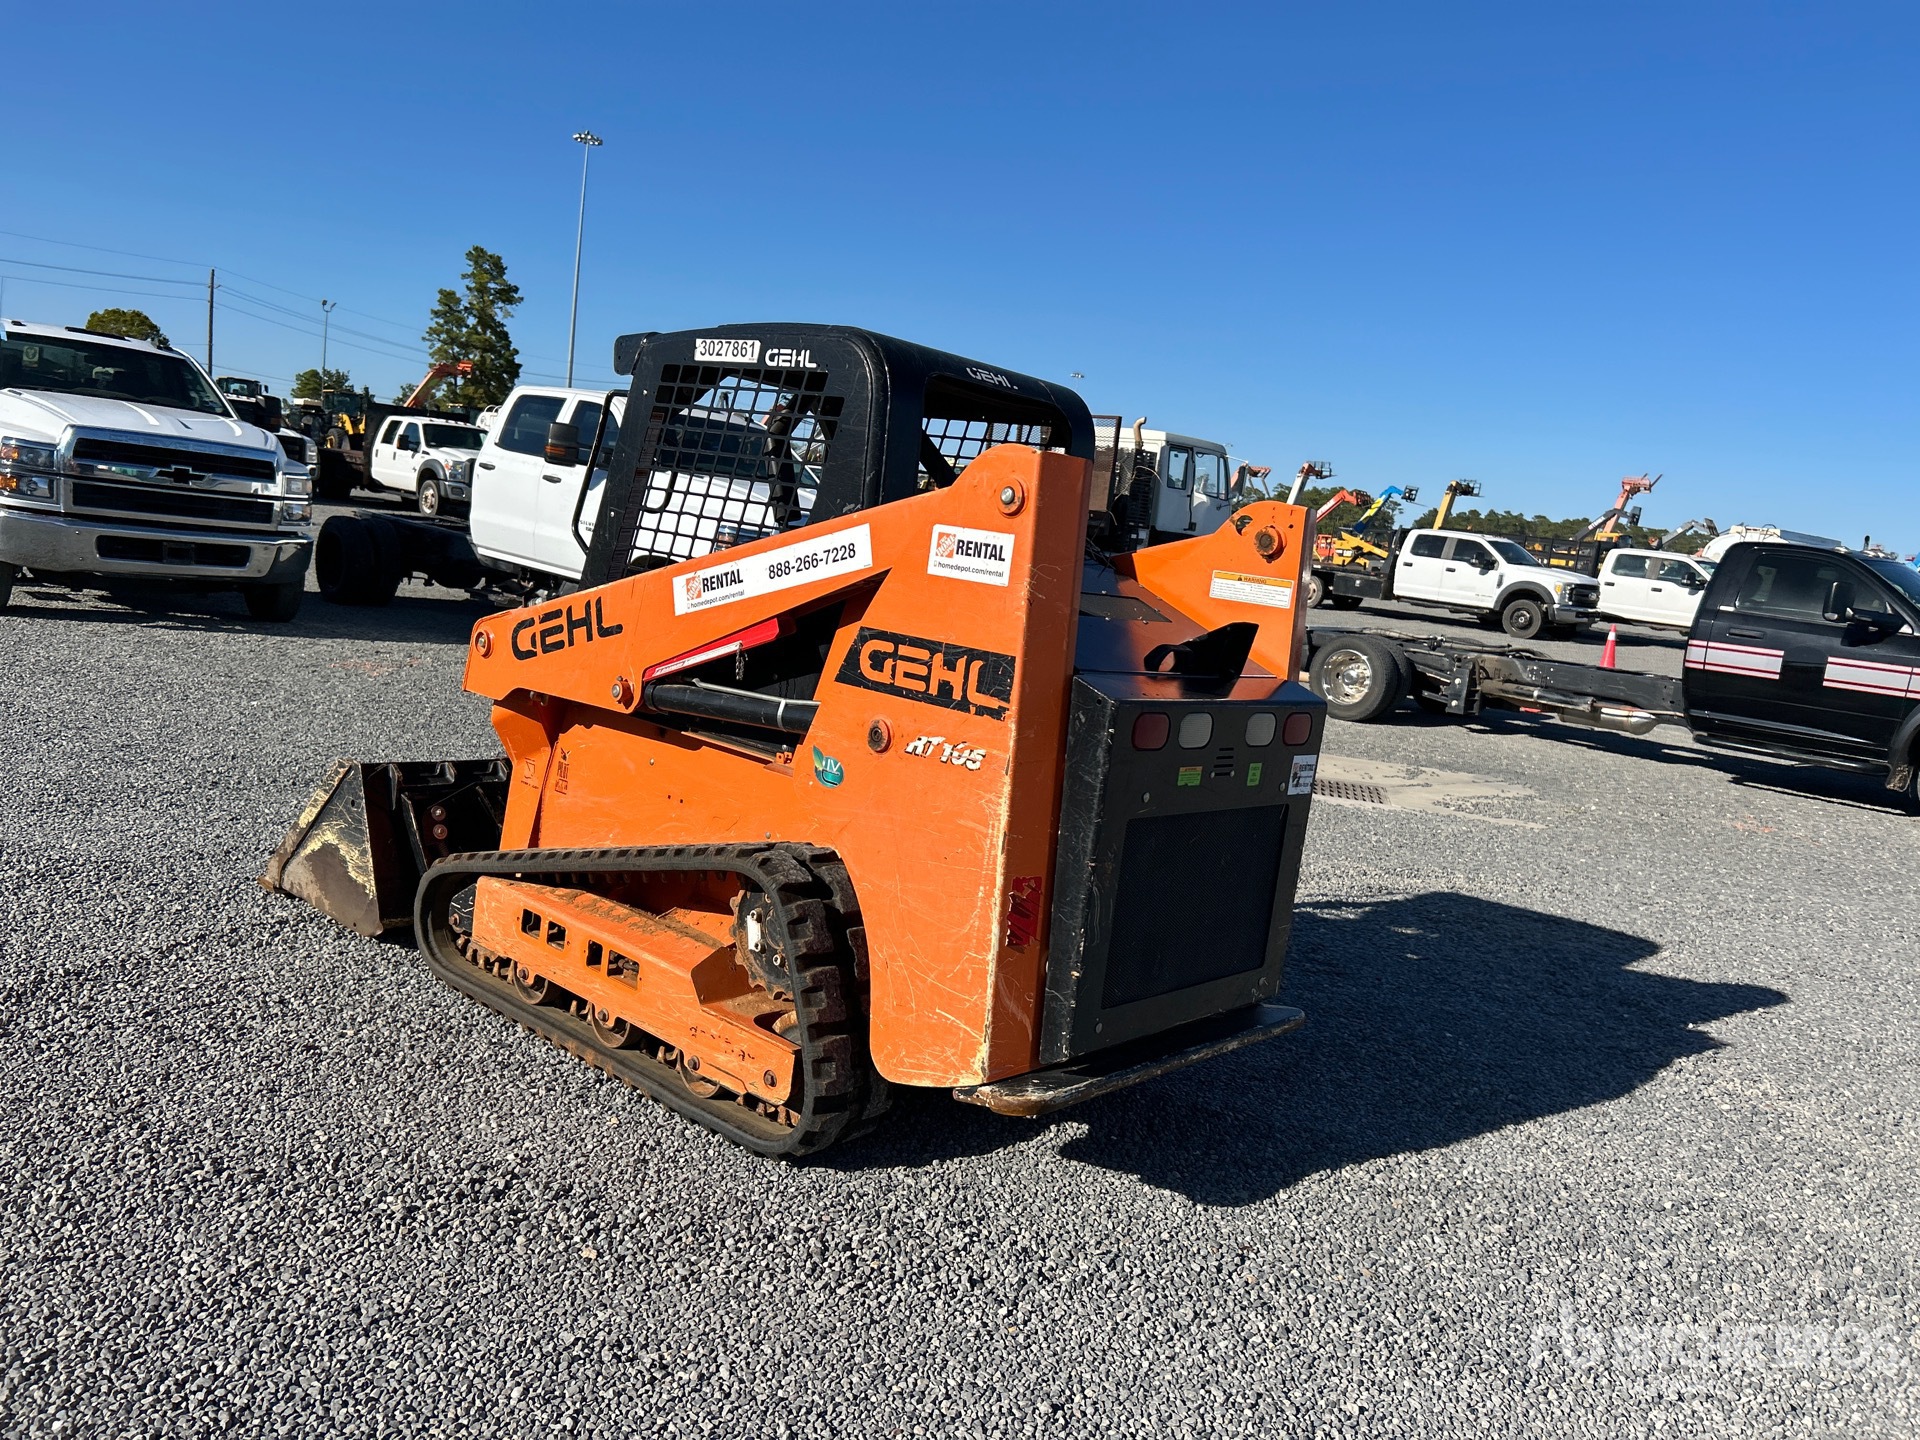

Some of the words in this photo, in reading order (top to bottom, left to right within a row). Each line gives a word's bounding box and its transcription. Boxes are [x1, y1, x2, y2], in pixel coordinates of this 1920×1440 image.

[700, 340, 756, 358] 3027861
[765, 348, 818, 368] GEHL
[955, 539, 1006, 562] RENTAL
[702, 568, 744, 593] RENTAL
[768, 543, 856, 580] 888-266-7228
[938, 561, 1004, 577] homedepot.com/rental
[690, 590, 745, 609] homedepot.com/rental
[511, 596, 624, 661] GEHL
[859, 639, 1010, 709] GEHL
[904, 735, 946, 758] RT
